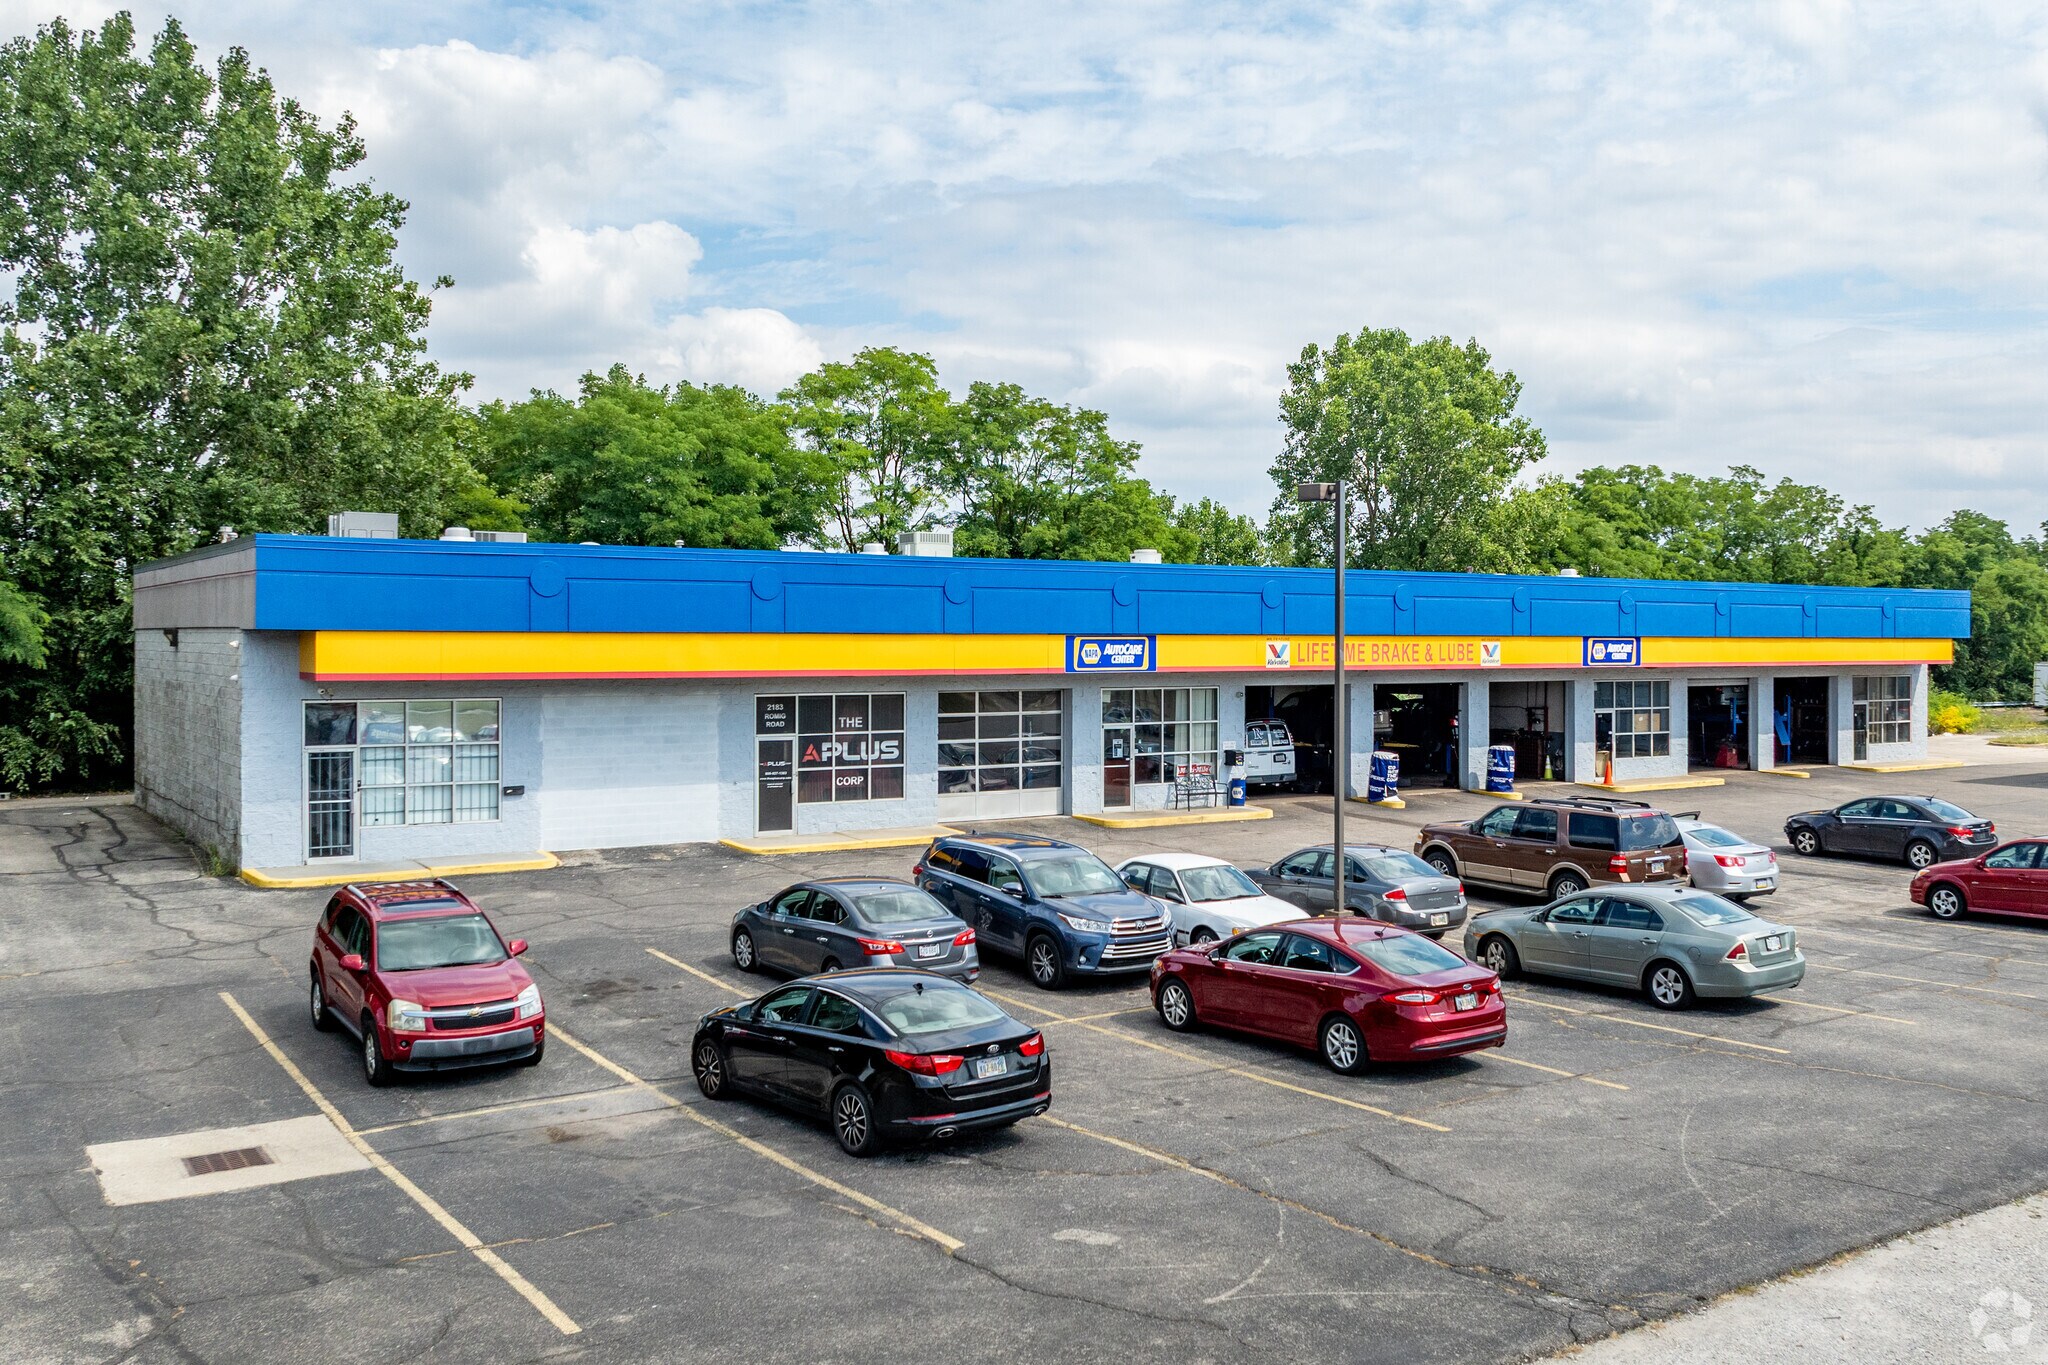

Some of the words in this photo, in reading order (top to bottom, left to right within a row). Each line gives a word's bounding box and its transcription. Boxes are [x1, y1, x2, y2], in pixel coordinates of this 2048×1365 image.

[1084, 649, 1098, 658] NAPA
[1298, 643, 1365, 662] LIFEME
[1371, 643, 1420, 662] BRAKE
[1425, 643, 1433, 662] &
[1439, 643, 1474, 662] LUBE
[1111, 655, 1135, 664] CENTER
[839, 716, 863, 728] THE
[801, 740, 900, 762] APLUS
[836, 776, 864, 786] CORP
